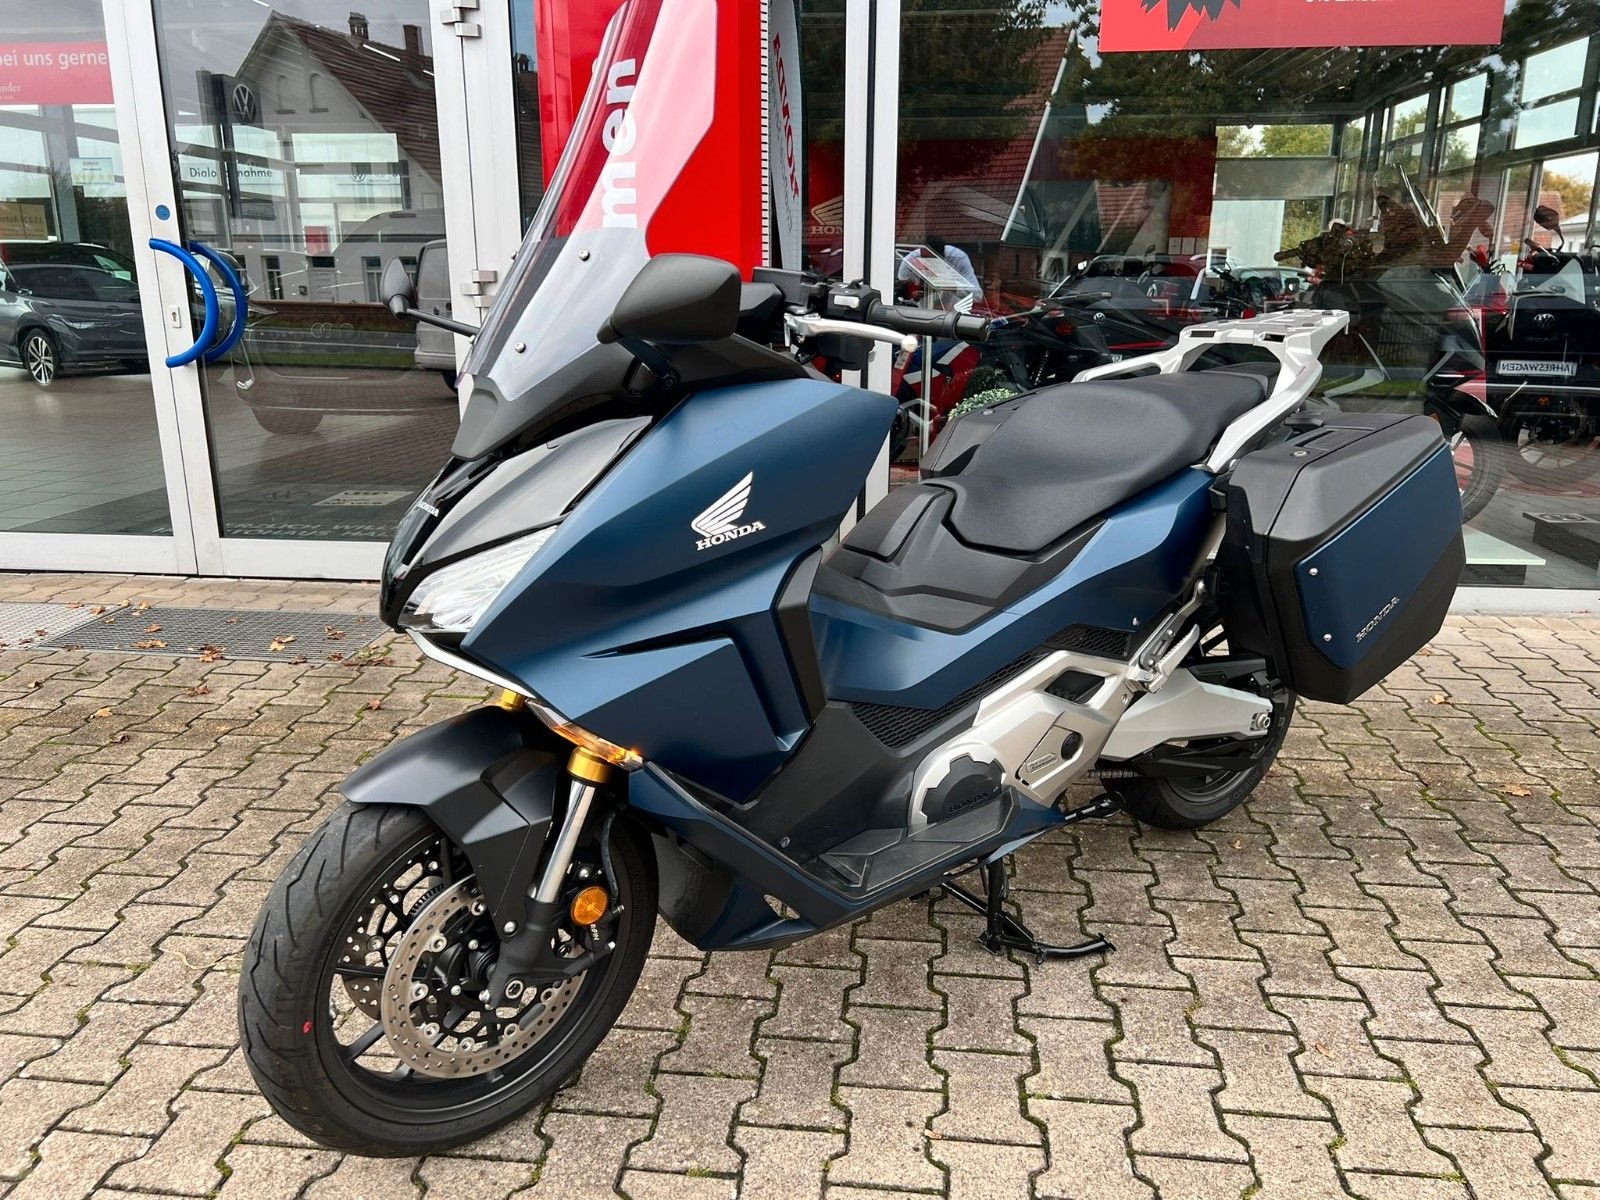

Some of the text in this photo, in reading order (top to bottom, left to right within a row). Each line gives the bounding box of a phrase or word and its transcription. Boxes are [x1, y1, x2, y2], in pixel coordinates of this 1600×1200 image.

[24, 52, 54, 66] uns
[59, 52, 107, 70] gerne
[189, 167, 273, 178] Dialonahme
[695, 520, 766, 551] HONDA
[1355, 597, 1400, 643] HONDA
